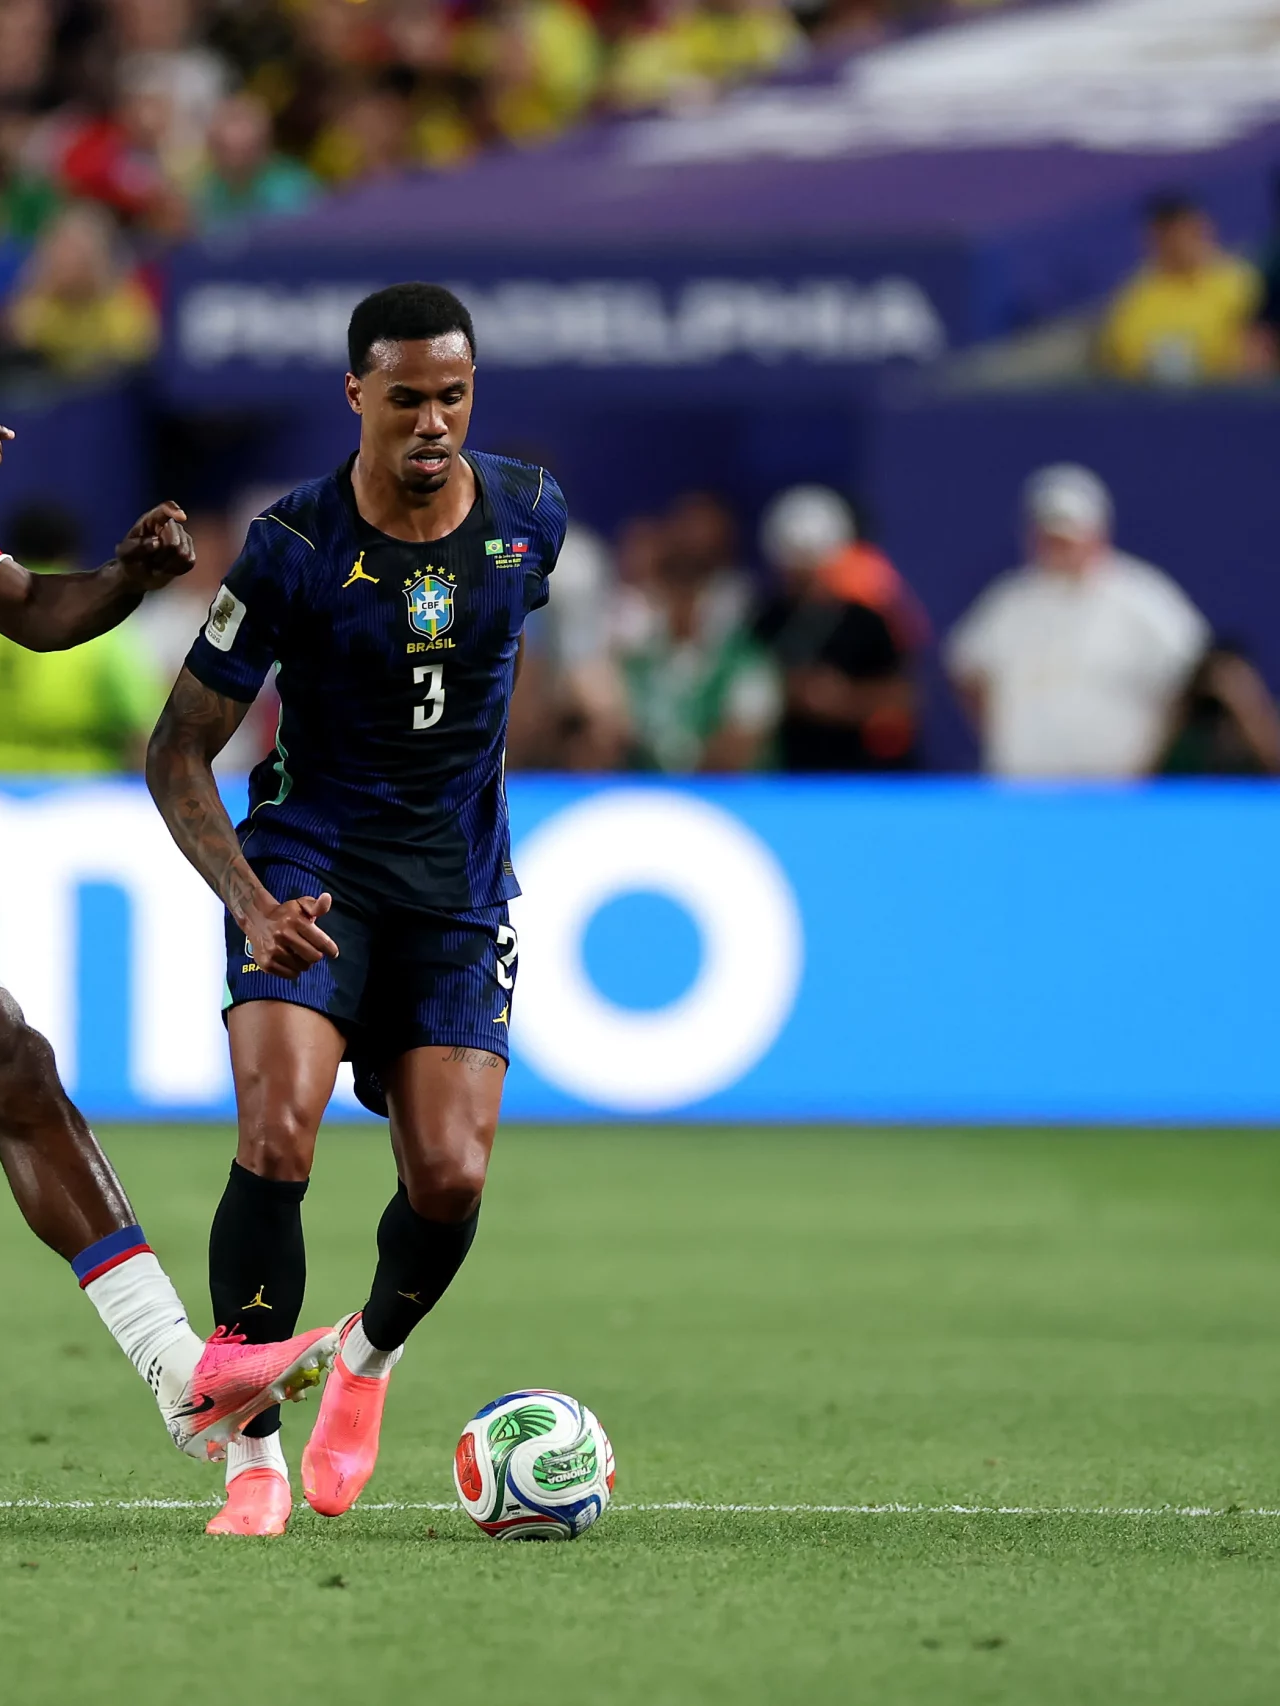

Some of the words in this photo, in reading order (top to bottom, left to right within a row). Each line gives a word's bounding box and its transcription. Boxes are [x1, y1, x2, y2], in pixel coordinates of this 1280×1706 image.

[421, 600, 440, 610] CBF
[406, 637, 456, 654] BRASIL
[413, 663, 446, 730] 3
[547, 1466, 592, 1484] TRIONDA
